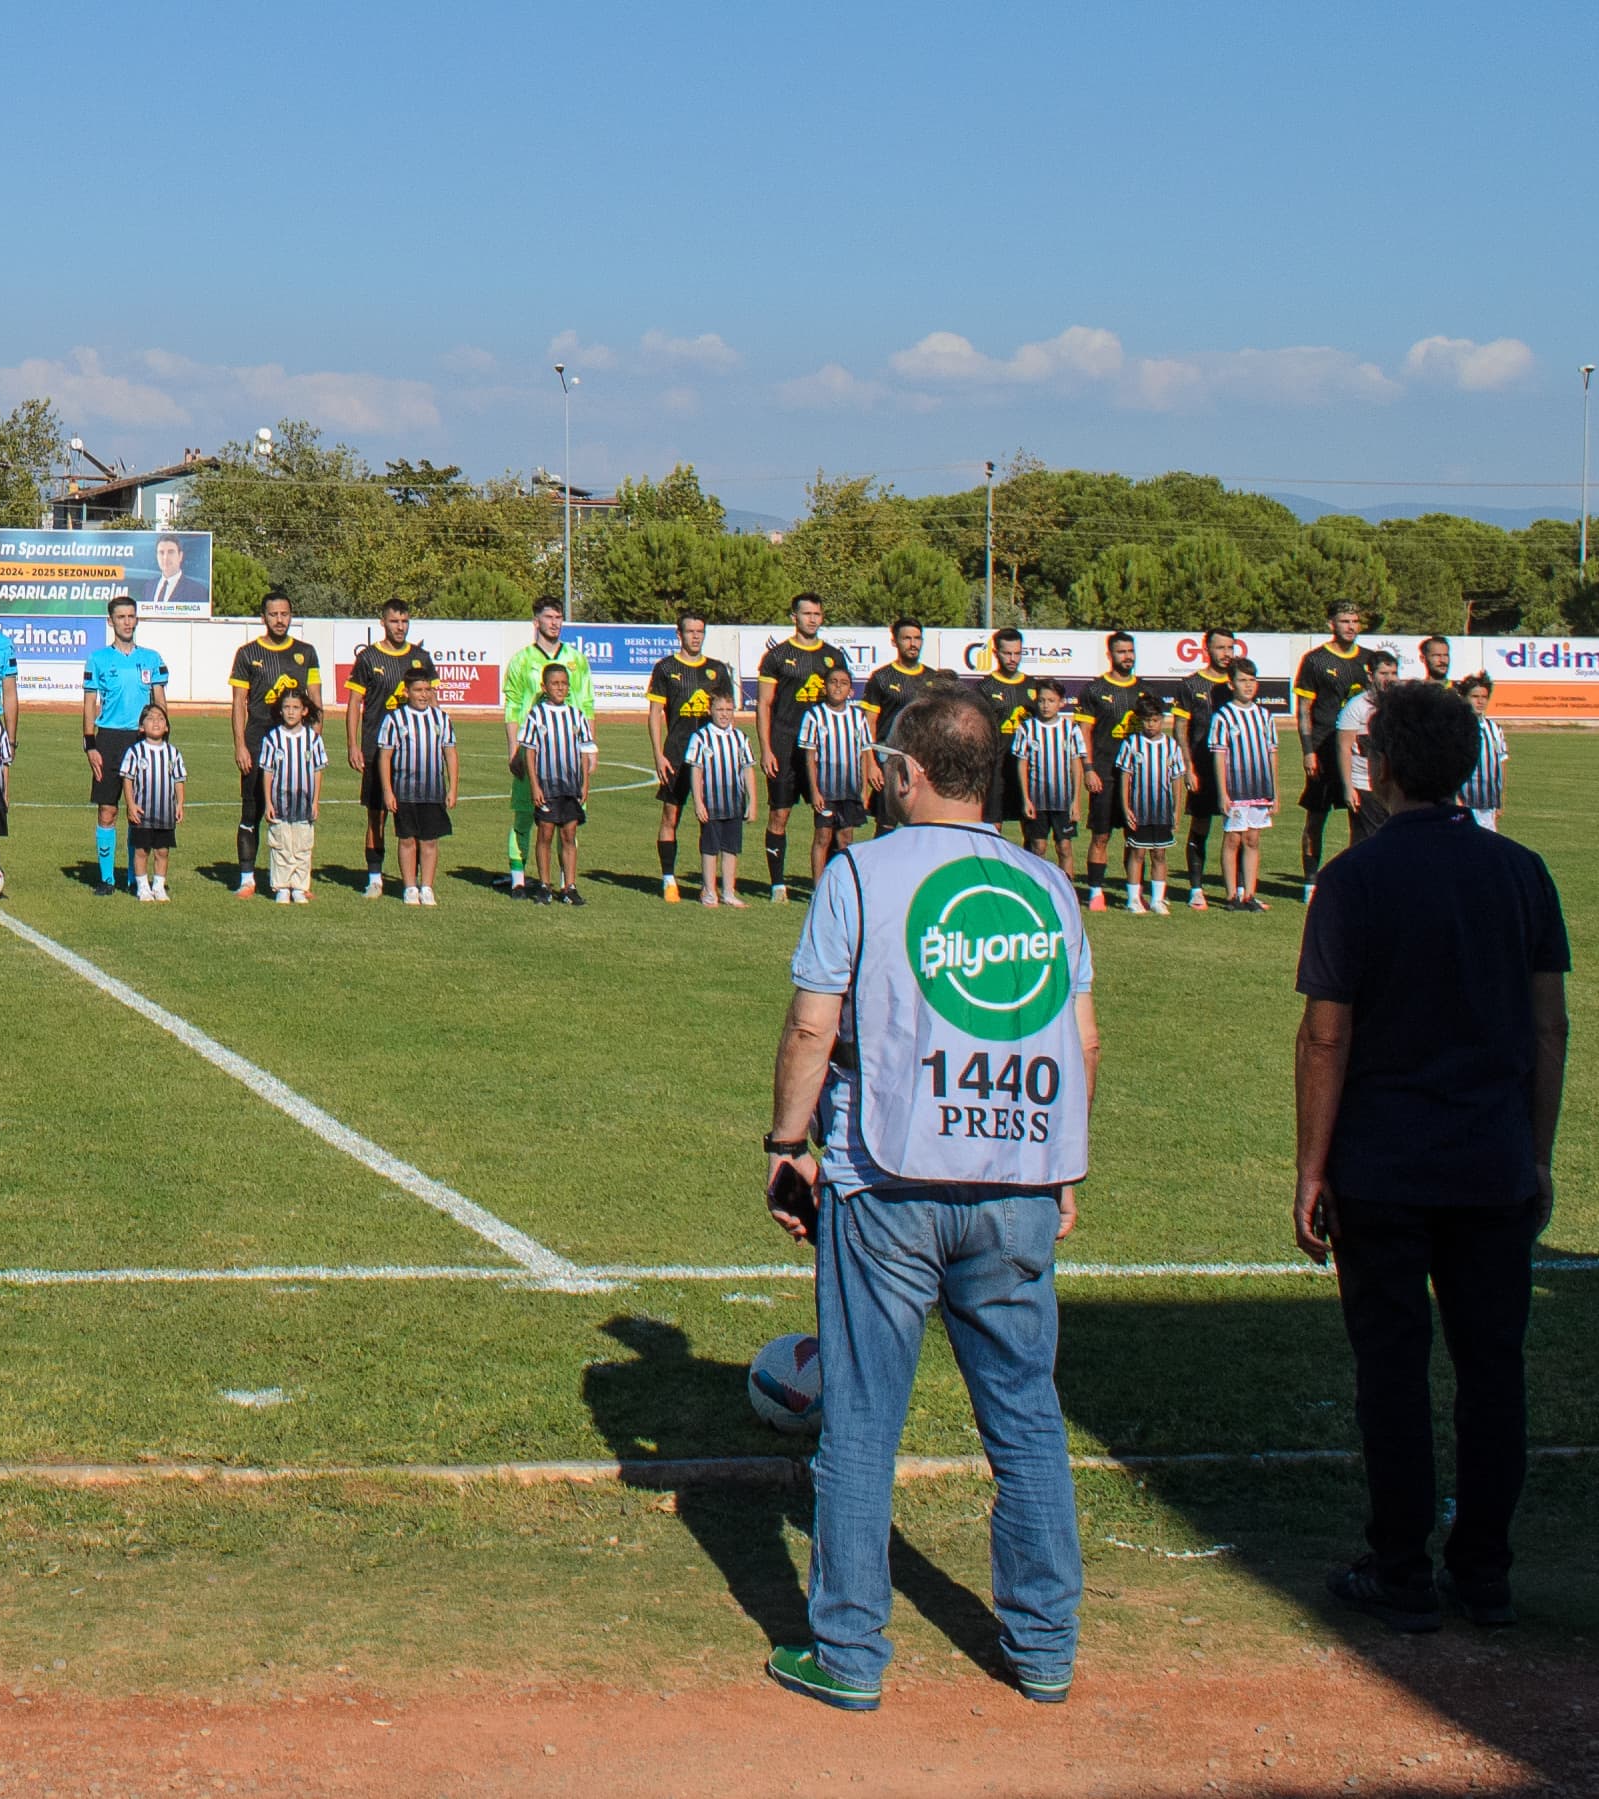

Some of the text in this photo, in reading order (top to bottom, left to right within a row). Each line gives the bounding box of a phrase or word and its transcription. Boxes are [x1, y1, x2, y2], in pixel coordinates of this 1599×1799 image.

[18, 541, 134, 559] Sporcularımıza
[0, 567, 24, 577] 2024
[31, 568, 56, 577] 2025
[58, 568, 117, 578] SEZONUNDA
[69, 583, 128, 600] DİLERİM
[624, 637, 650, 646] DERİN
[433, 648, 487, 661] enter
[1021, 647, 1072, 657] STLAR
[434, 666, 479, 681] IMINA
[434, 690, 465, 702] LERİZ
[920, 925, 1064, 979] Bilyoner
[921, 1049, 1061, 1106] 1440
[938, 1104, 1049, 1143] PRESS
